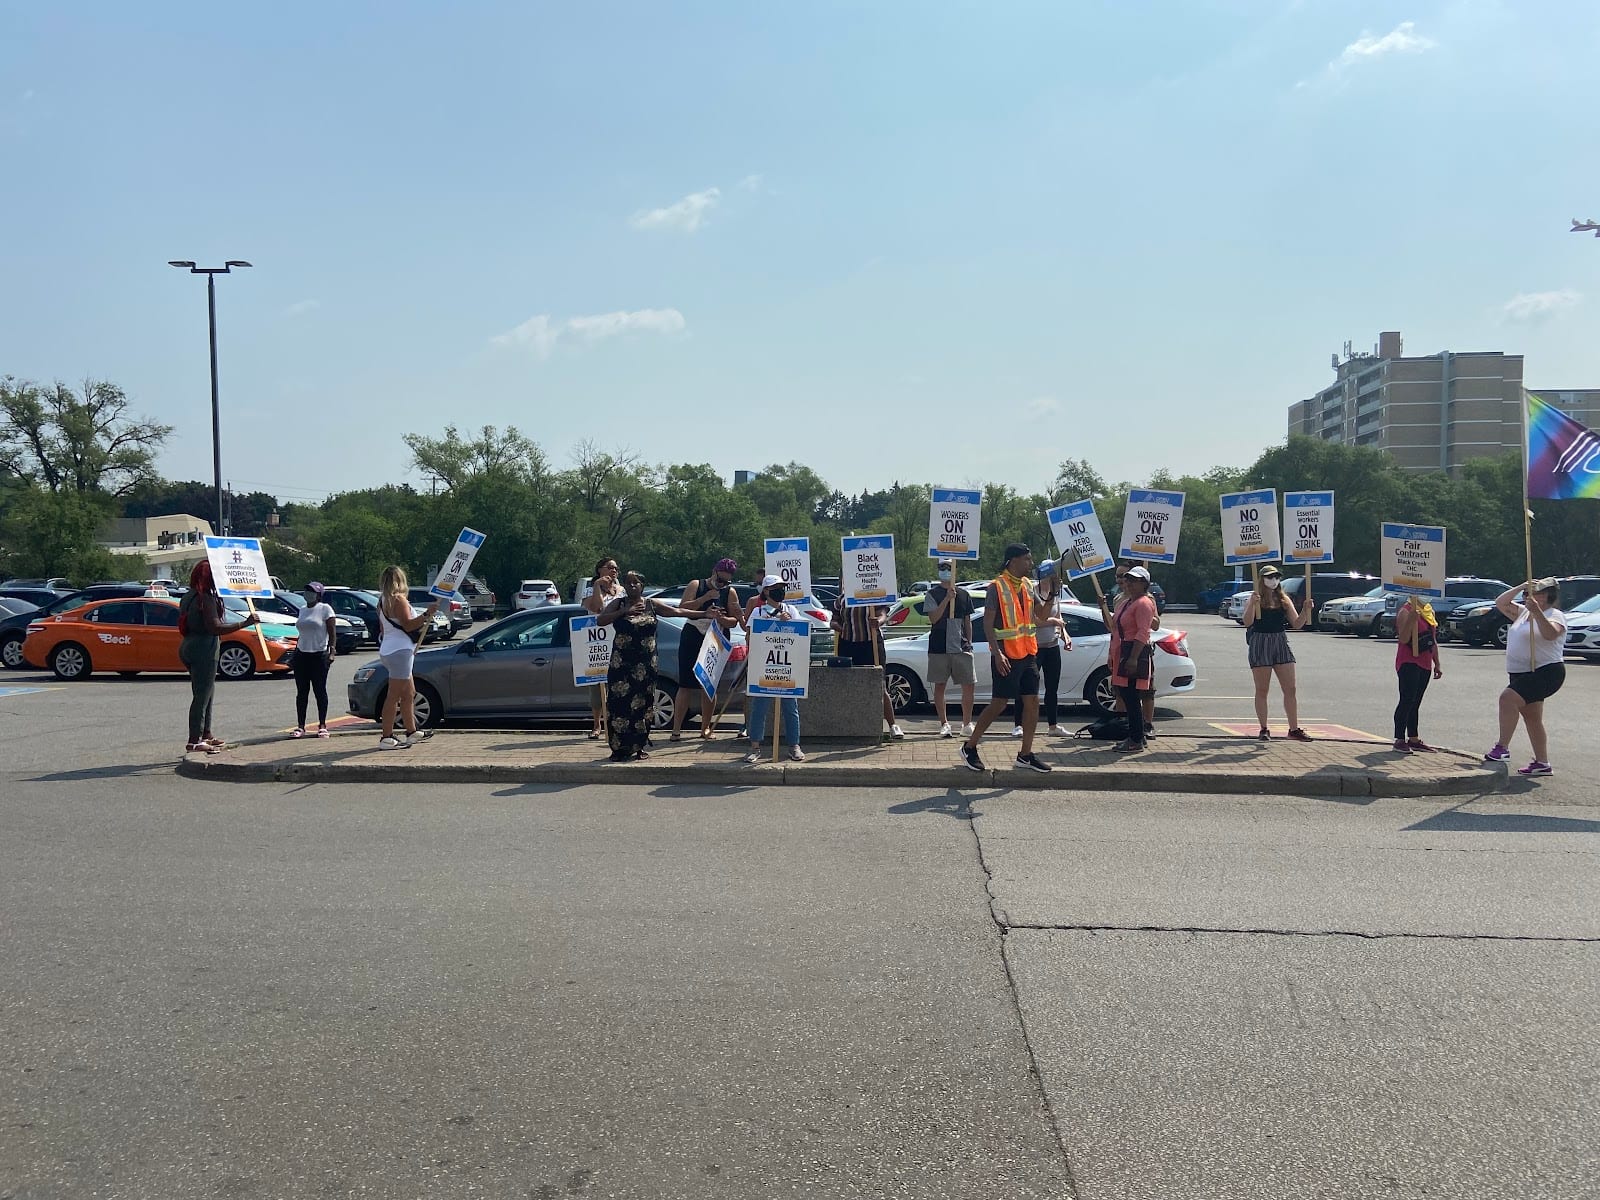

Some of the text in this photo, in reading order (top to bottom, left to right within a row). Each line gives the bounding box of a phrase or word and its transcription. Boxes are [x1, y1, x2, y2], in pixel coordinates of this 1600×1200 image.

[941, 510, 969, 520] WORKERS
[1137, 510, 1170, 521] WORKERS
[1240, 508, 1259, 522] NO
[1296, 509, 1321, 517] Essential
[944, 519, 964, 534] ON
[1068, 521, 1086, 537] NO
[1140, 520, 1163, 535] ON
[1241, 524, 1260, 533] ZERO
[1299, 524, 1318, 539] ON
[940, 534, 967, 544] STRIKE
[1073, 536, 1090, 547] ZERO
[1135, 534, 1165, 545] STRIKE
[1239, 532, 1262, 541] WAGE
[1295, 539, 1321, 549] STRIKE
[1403, 540, 1422, 550] Fair
[857, 553, 879, 563] Black
[1394, 548, 1431, 559] Contract!
[451, 560, 464, 574] ON
[776, 559, 802, 568] WORKERS
[857, 562, 880, 572] Creek
[781, 567, 798, 581] ON
[785, 582, 801, 591] RIKE
[101, 633, 131, 644] Beck
[588, 627, 607, 642] NO
[764, 636, 794, 645] Solidarity
[589, 644, 608, 654] ZERO
[588, 652, 610, 662] WAGE
[765, 650, 792, 666] ALL
[765, 667, 792, 675] essential
